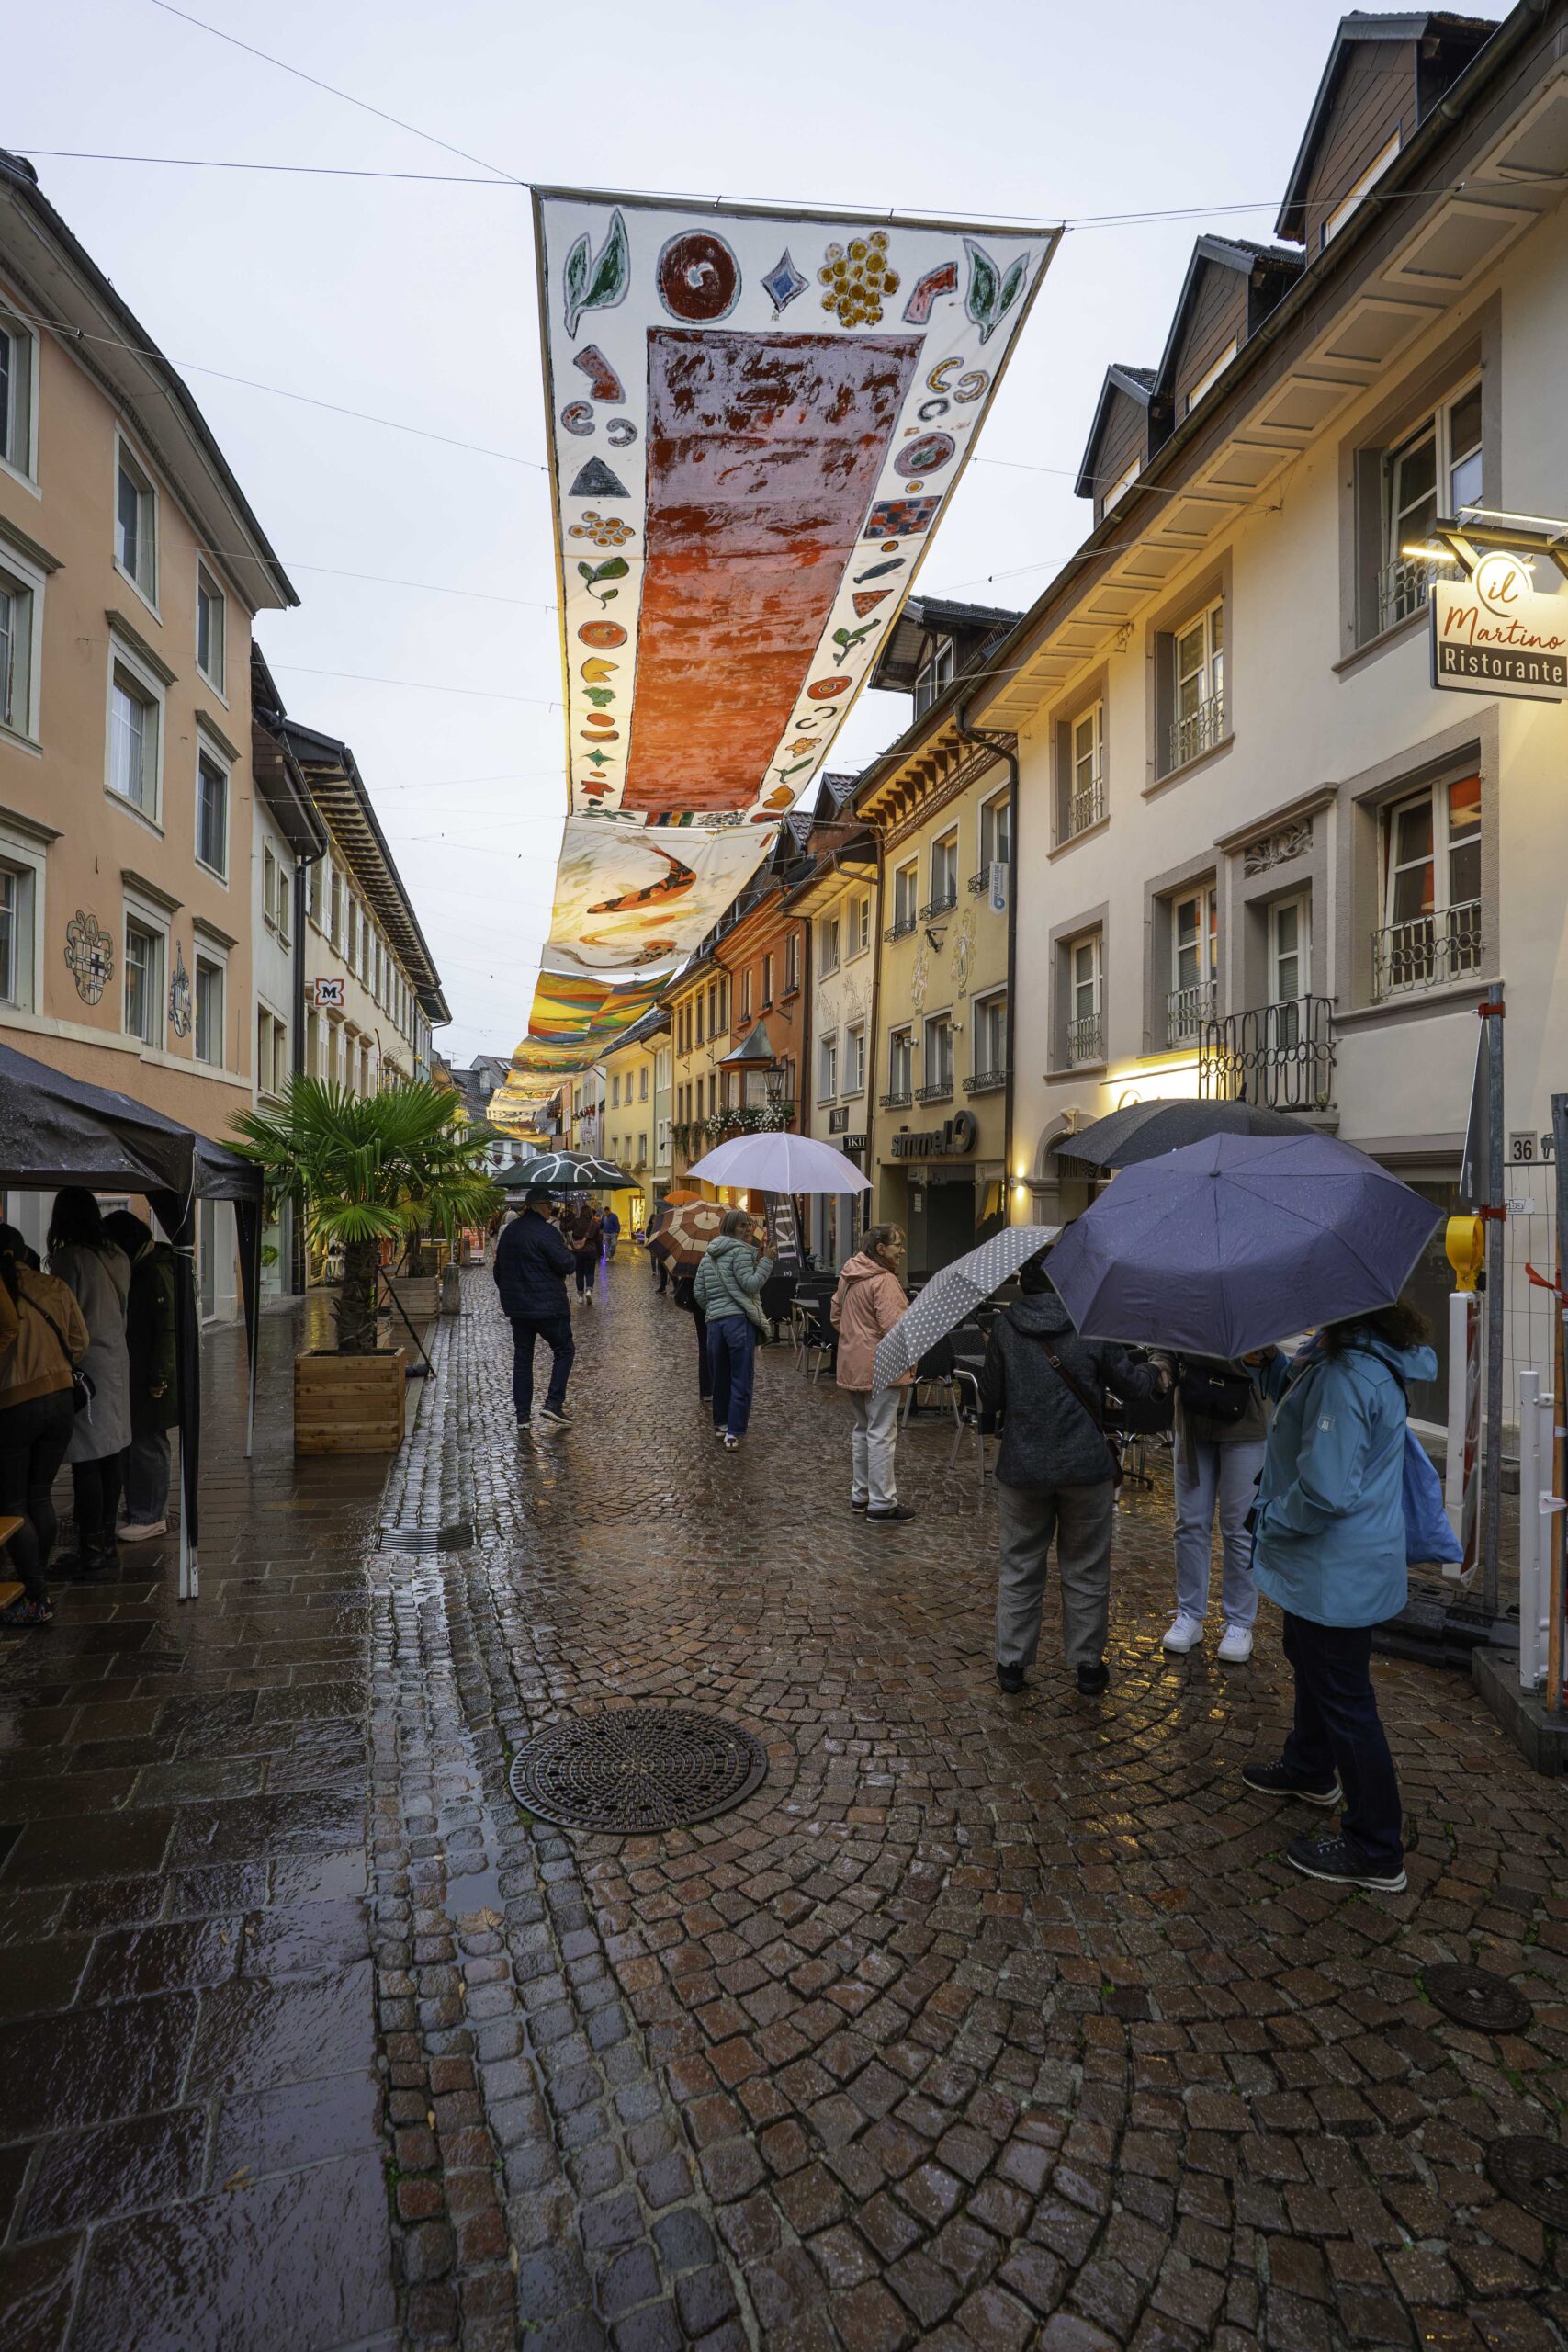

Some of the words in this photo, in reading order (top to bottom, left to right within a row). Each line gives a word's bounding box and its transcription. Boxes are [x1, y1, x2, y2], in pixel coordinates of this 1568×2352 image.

[1487, 571, 1518, 603] il
[1443, 606, 1566, 650] Martino
[1445, 648, 1562, 683] Ristorante
[321, 986, 337, 999] M
[1513, 1140, 1532, 1160] 36
